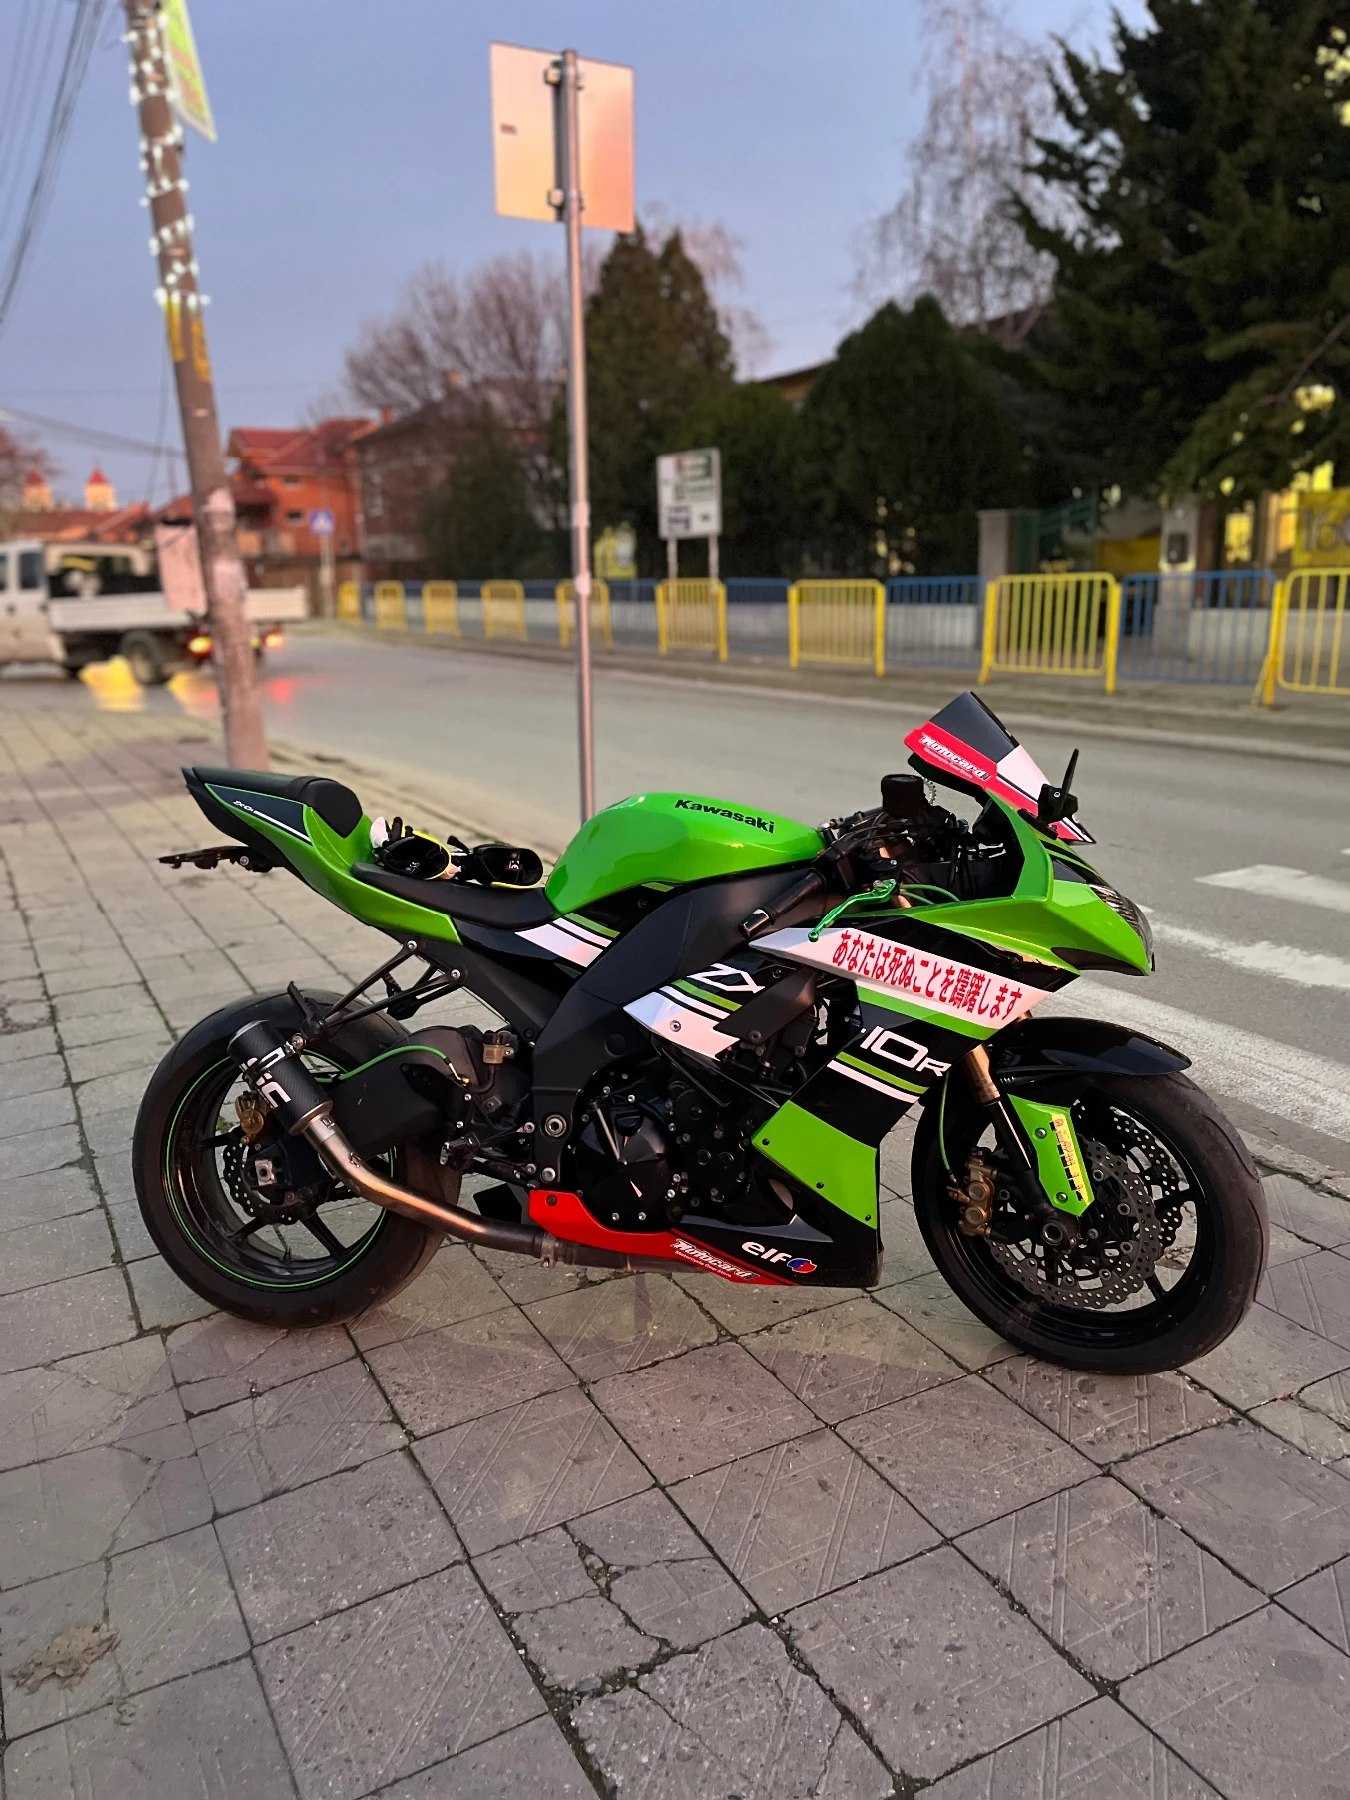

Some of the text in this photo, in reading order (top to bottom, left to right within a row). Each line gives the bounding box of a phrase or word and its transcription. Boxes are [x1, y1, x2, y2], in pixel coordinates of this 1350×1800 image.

[919, 733, 989, 780] Motocard
[674, 799, 775, 835] Kawasaki
[686, 962, 766, 994] ZX
[832, 930, 1023, 1021] あなたは死ぬことを躊躇します
[860, 1025, 952, 1077] 10R
[670, 1238, 758, 1280] Motocard
[674, 1249, 704, 1267] Motorcycle
[741, 1241, 792, 1263] elf
